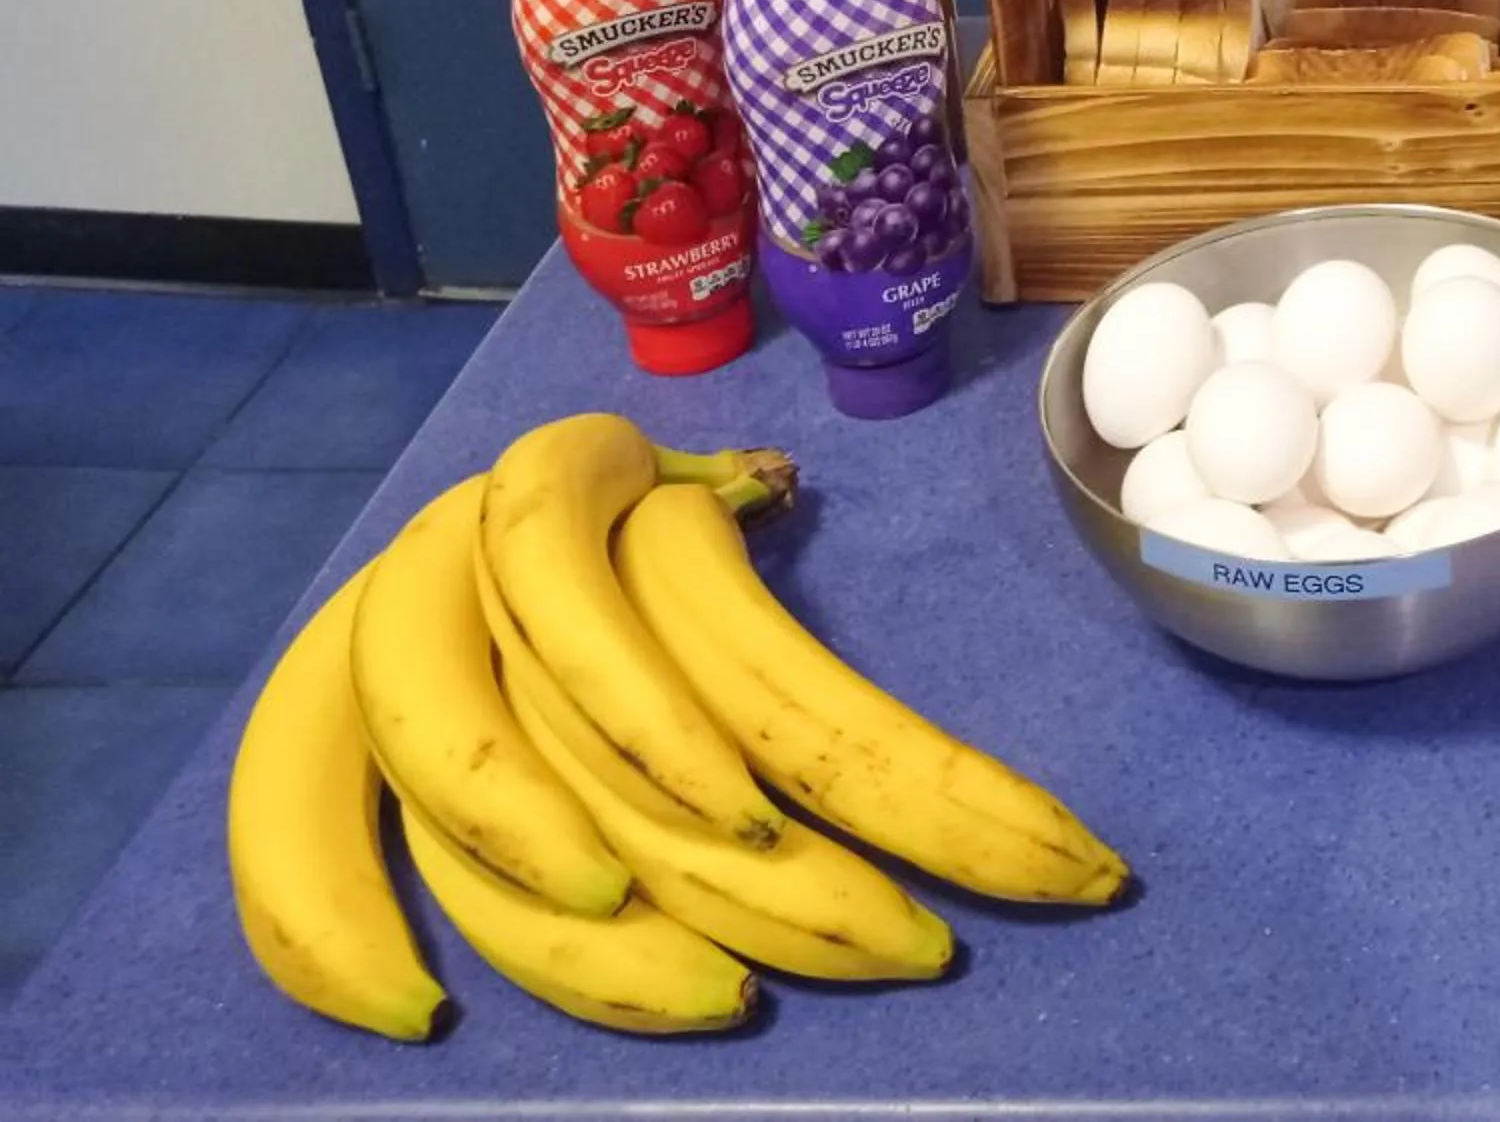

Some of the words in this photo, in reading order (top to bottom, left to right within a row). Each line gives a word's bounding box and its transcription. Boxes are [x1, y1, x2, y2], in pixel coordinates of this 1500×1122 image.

[559, 4, 707, 57] SMUCKER'S
[796, 25, 941, 84] SMUCKER'S
[624, 232, 739, 281] STRAWBERRY
[882, 271, 941, 303] GRAPE
[1212, 563, 1275, 591] RAW
[1283, 574, 1364, 594] EGGS
